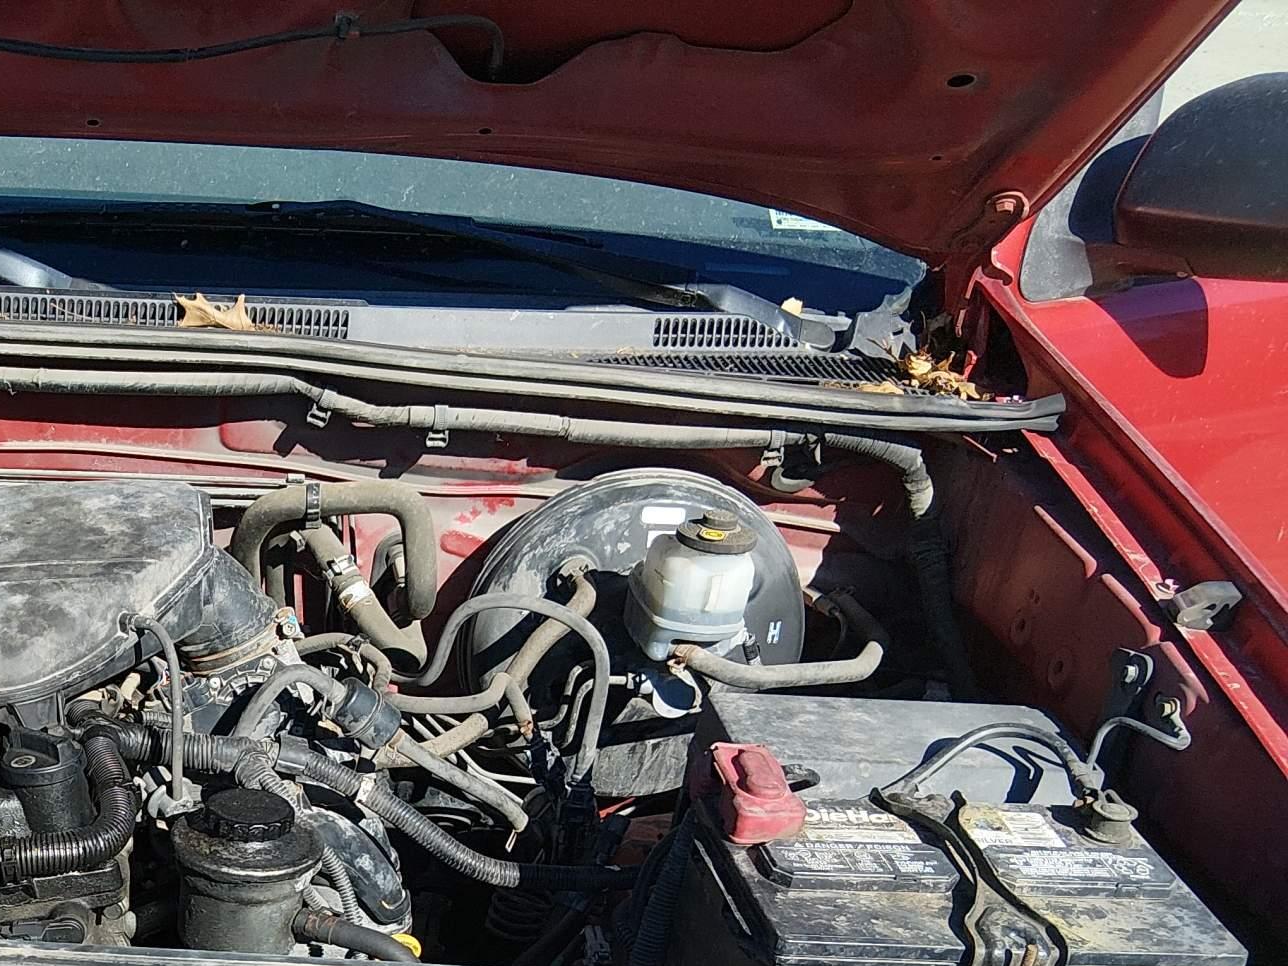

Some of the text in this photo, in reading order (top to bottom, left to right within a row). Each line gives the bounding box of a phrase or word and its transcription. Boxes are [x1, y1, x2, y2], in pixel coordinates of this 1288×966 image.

[766, 620, 782, 644] H
[805, 842, 853, 850] DANGER
[865, 843, 911, 851] POISON
